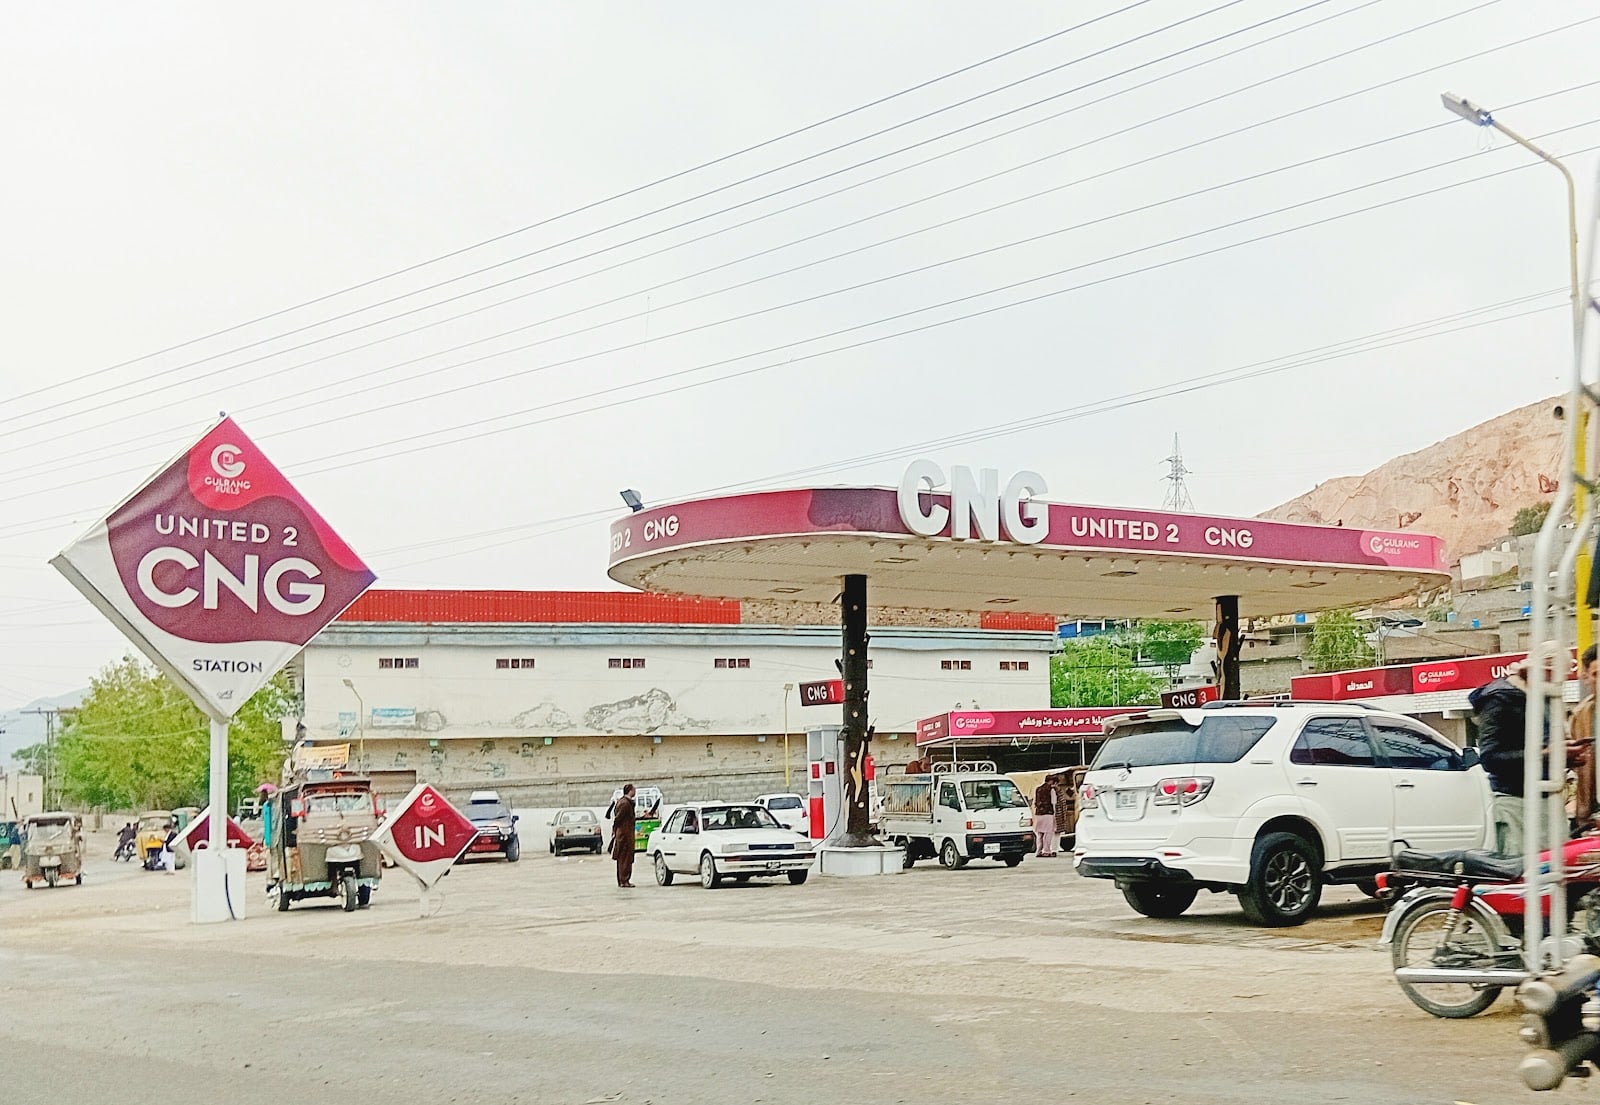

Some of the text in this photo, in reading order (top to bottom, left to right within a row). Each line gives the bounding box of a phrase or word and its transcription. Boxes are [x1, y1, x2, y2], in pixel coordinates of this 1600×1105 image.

[204, 476, 251, 490] GULRANG
[215, 485, 241, 495] FUELS
[896, 459, 1050, 545] CNG
[155, 514, 298, 547] UNITED 2
[624, 527, 631, 548] 2
[643, 515, 680, 542] CNG
[1071, 516, 1254, 549] UNITED 2 CNG
[1383, 537, 1420, 549] GULRANG
[136, 546, 326, 616] CNG
[192, 659, 263, 673] STATION
[807, 684, 836, 701] CNG 1
[1171, 691, 1207, 707] CNG 3
[1084, 717, 1091, 725] 2
[414, 823, 446, 849] IN
